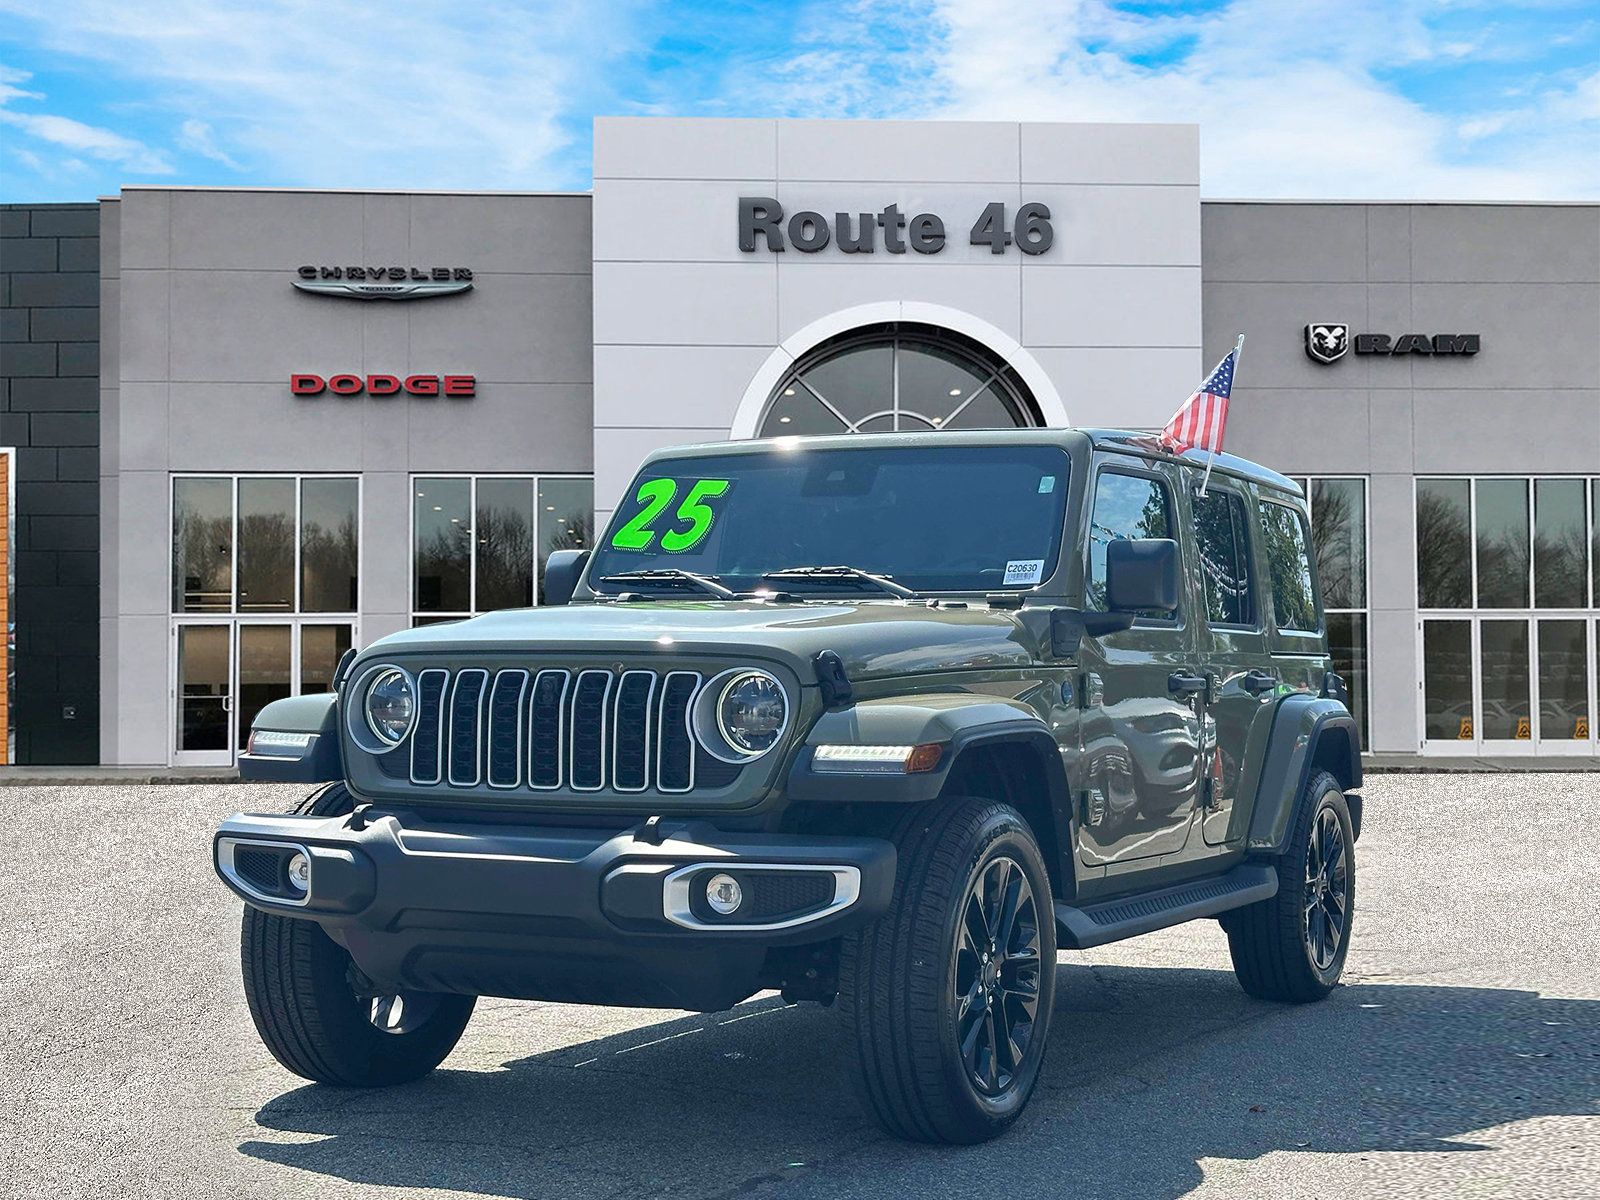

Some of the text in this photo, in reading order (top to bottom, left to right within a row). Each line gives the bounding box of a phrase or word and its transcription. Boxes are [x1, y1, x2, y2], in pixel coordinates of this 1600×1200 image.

[739, 197, 1054, 256] Route 46
[298, 266, 473, 280] CHRYSLER
[1355, 334, 1481, 355] RAM
[291, 374, 476, 397] DODGE
[611, 478, 731, 554] 25
[1007, 563, 1038, 573] C20630
